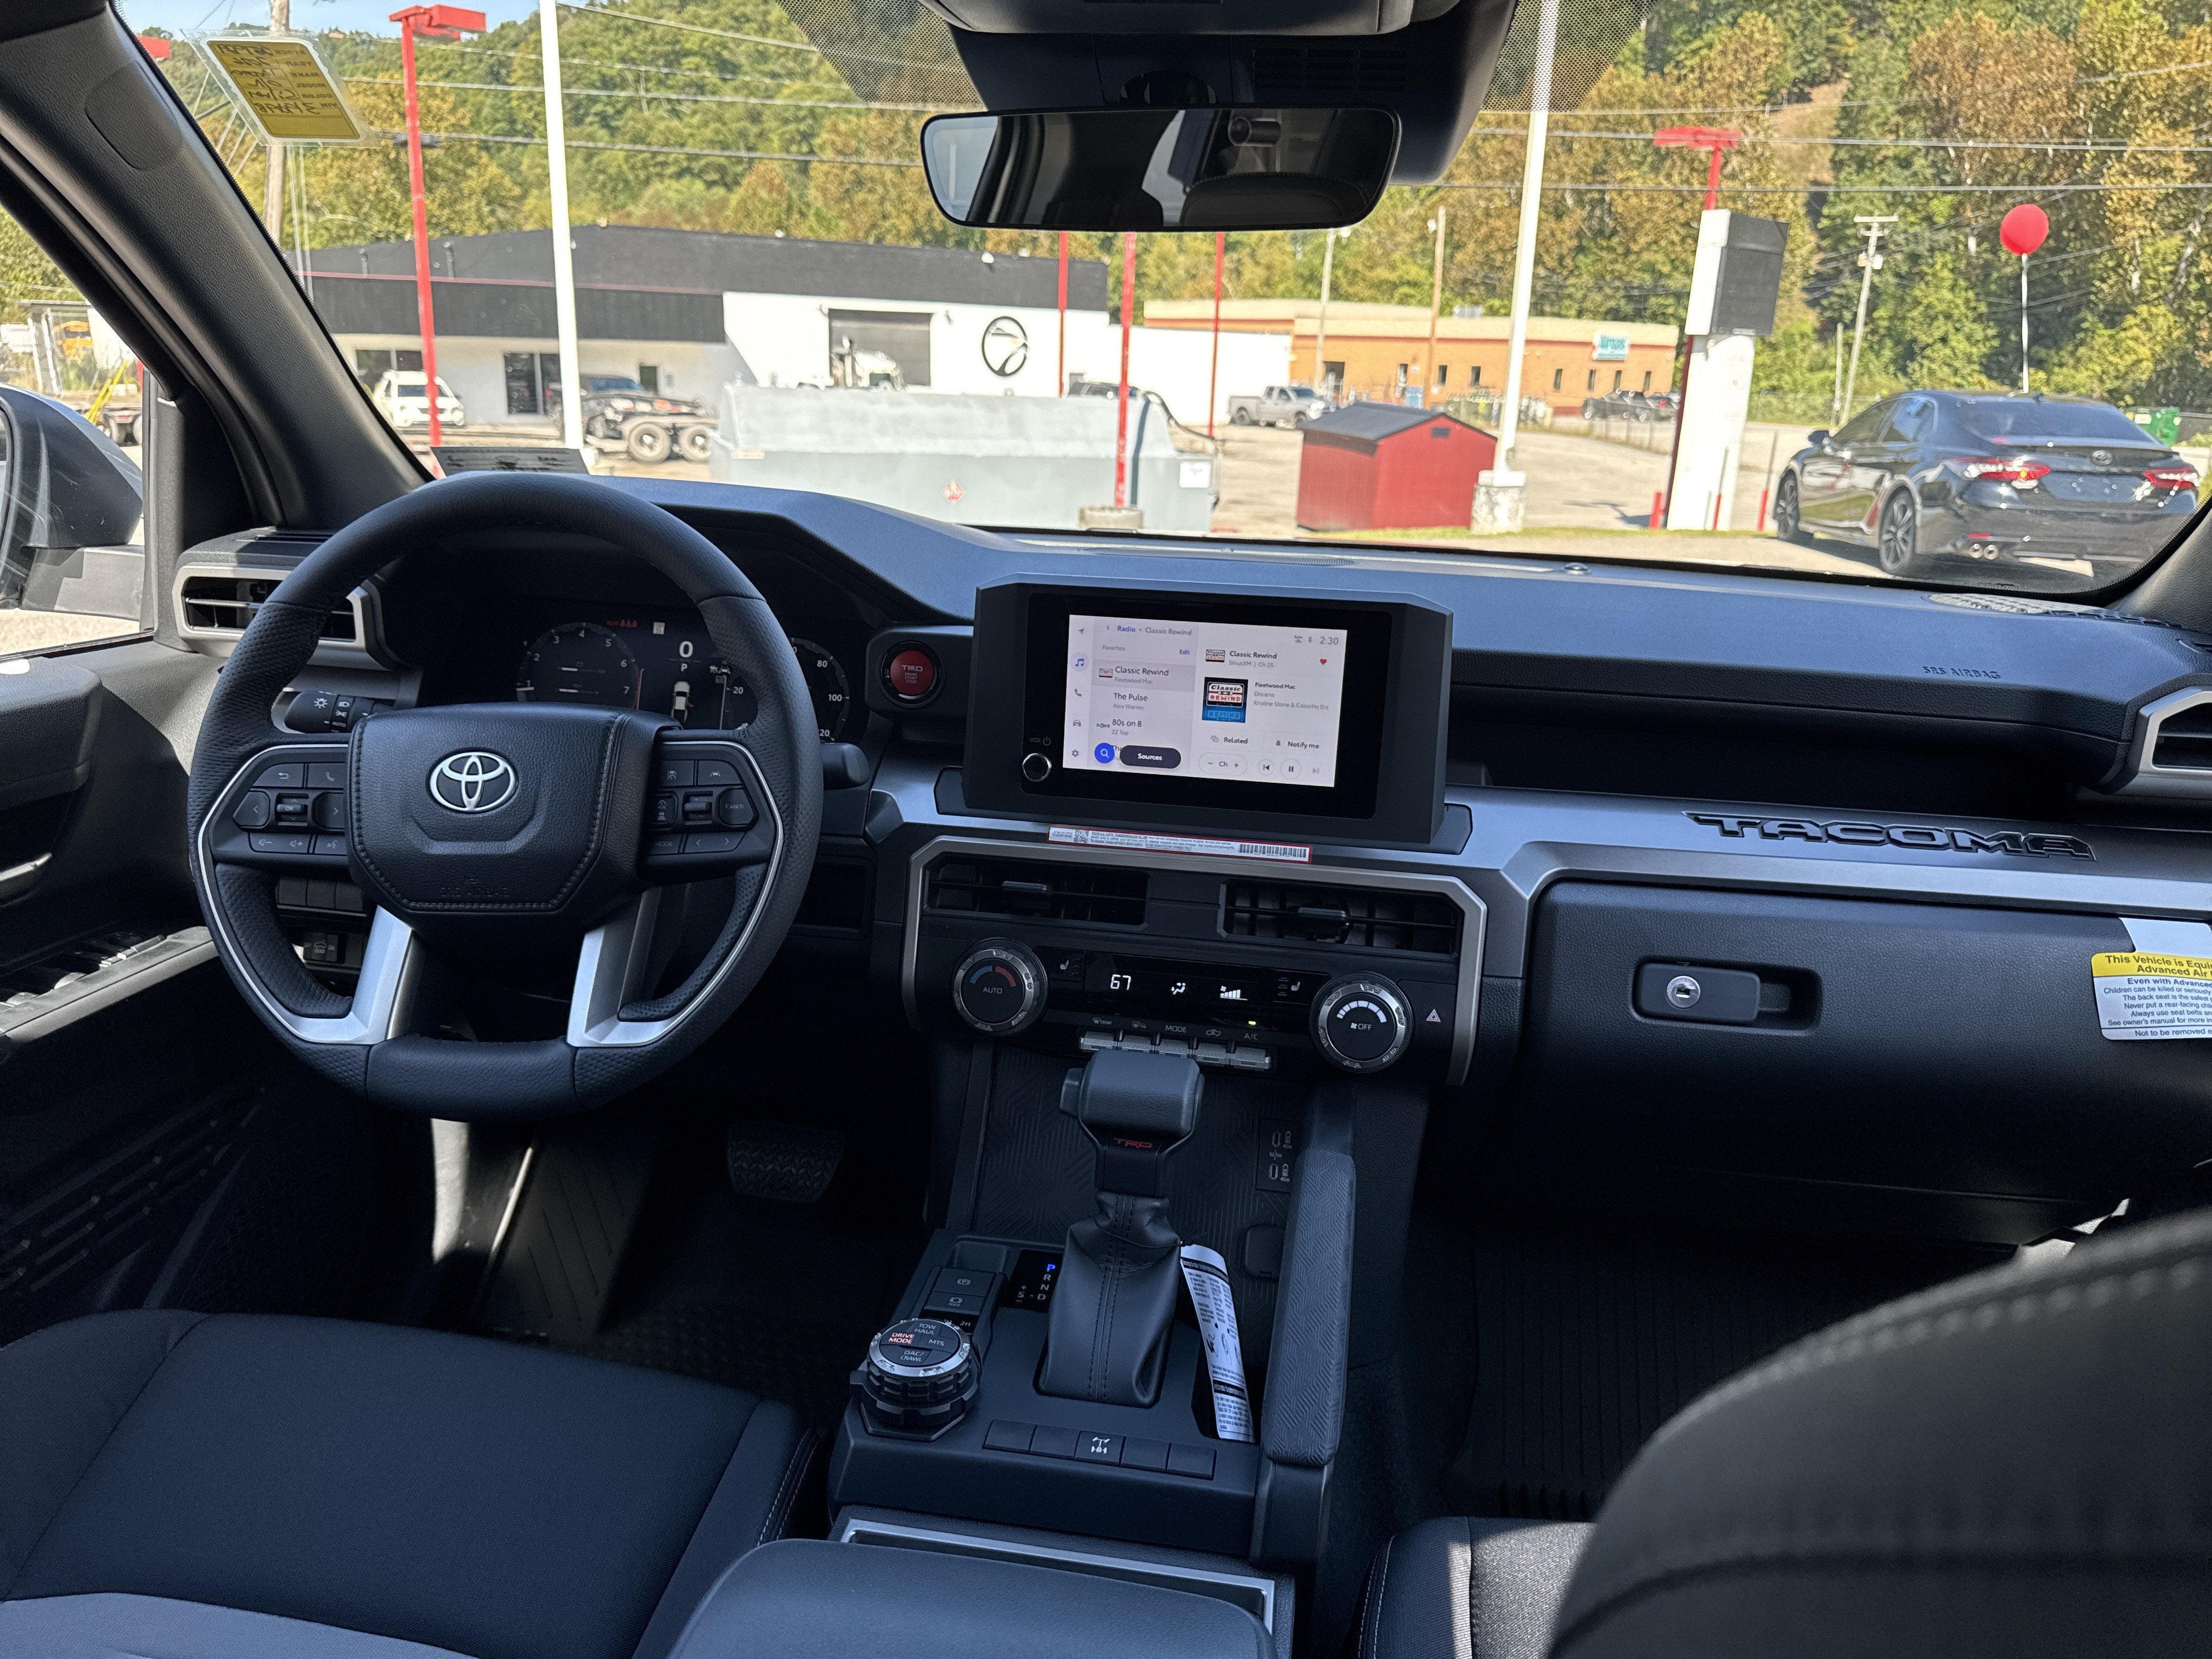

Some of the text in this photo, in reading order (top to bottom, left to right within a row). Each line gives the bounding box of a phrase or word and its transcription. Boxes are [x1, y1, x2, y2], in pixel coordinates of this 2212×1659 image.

[578, 630, 586, 638] 4
[554, 636, 561, 644] 3
[605, 638, 612, 647] 5
[1319, 636, 1339, 645] 2:30
[679, 641, 693, 658] 0
[533, 653, 541, 662] 2
[620, 659, 628, 668] 6
[680, 663, 688, 672] P
[1115, 666, 1169, 676] Classic Rewind
[1922, 666, 2001, 679] SRS AIRBAG
[732, 686, 744, 695] 20
[1128, 693, 1148, 702] Pulse
[1288, 741, 1308, 749] Notify
[1137, 753, 1163, 761] Sources
[1681, 810, 2098, 862] TACOMA
[2104, 955, 2212, 977] This Vehicle is Equi
[2137, 964, 2208, 978] Advanced Air
[1110, 974, 1132, 991] 67
[2183, 988, 2211, 996] seriously
[1165, 1024, 1187, 1033] MODE
[1357, 1023, 1373, 1031] OFF
[1244, 1032, 1259, 1040] A/C
[1046, 1263, 1056, 1272] P
